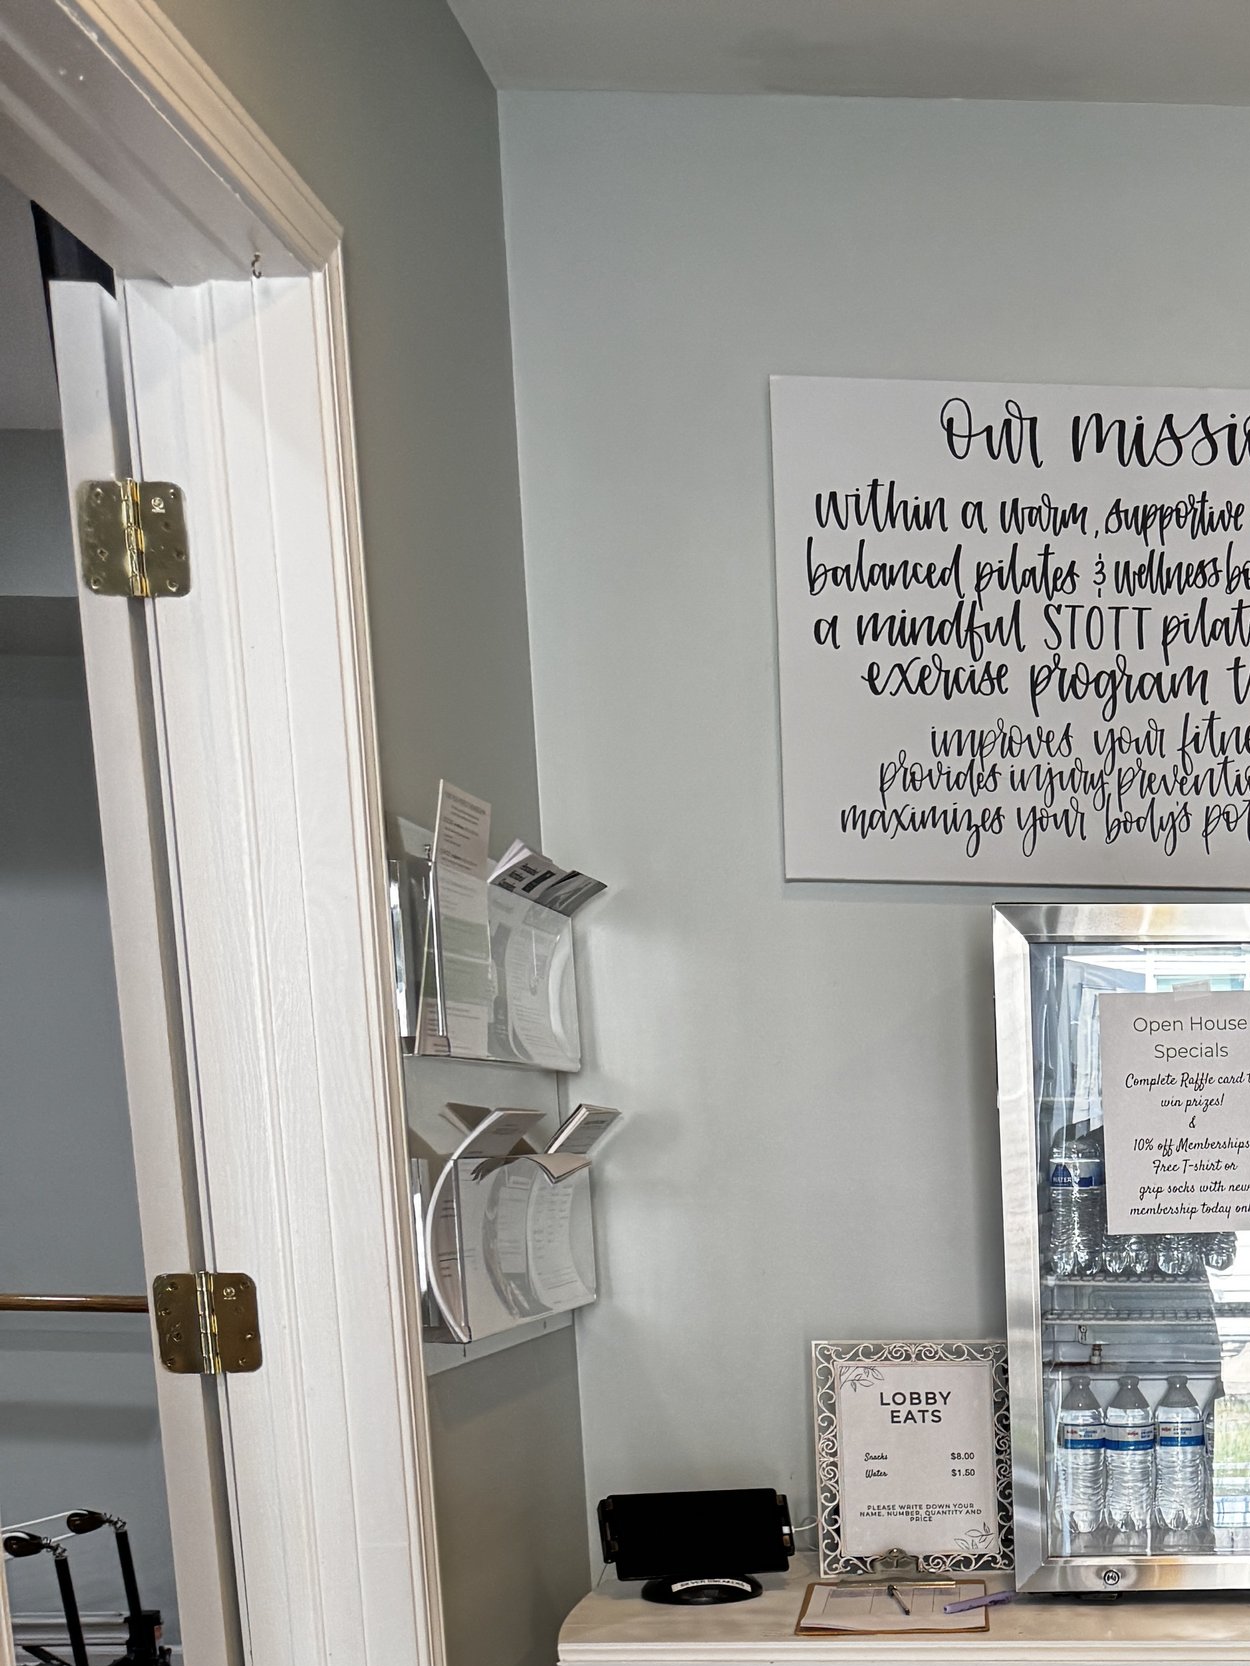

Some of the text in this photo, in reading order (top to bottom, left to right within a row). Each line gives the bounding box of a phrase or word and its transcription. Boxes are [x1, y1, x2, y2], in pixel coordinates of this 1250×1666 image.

[940, 397, 1043, 469] Our
[815, 478, 949, 532] within
[961, 500, 988, 534] a
[999, 492, 1101, 539] warm,
[1105, 491, 1246, 546] supportive
[806, 536, 965, 599] balanced
[974, 542, 1080, 614] pilates
[813, 616, 838, 649] a
[857, 601, 1026, 661] mindful
[1042, 604, 1152, 650] STOTT
[861, 653, 1010, 699] exercise
[1030, 652, 1208, 720] program
[931, 717, 1072, 772] improves
[1093, 717, 1165, 773] your
[879, 749, 1001, 812] provides
[1009, 756, 1108, 812] injury
[840, 798, 1005, 858] maximizes
[1016, 797, 1086, 857] your
[1104, 794, 1192, 856] body's
[1133, 1016, 1248, 1035] Open House
[1154, 1043, 1229, 1061] Specials
[1125, 1073, 1177, 1091] Complete
[1180, 1072, 1214, 1091] Raffle
[1218, 1072, 1244, 1084] card
[1161, 1094, 1225, 1112] win prizes!
[1189, 1116, 1196, 1128] &
[1134, 1138, 1154, 1151] 10%
[1157, 1138, 1175, 1157] off
[1153, 1159, 1238, 1174] Free T-shirt or
[1139, 1184, 1164, 1200] grip
[1168, 1182, 1195, 1194] socks
[1200, 1182, 1226, 1192] with
[1130, 1203, 1198, 1219] membership
[1201, 1202, 1231, 1218] today
[880, 1392, 951, 1406] LOBBY
[891, 1410, 942, 1423] EATS
[950, 1452, 974, 1460] $8.00
[865, 1469, 975, 1478] Water $1.50
